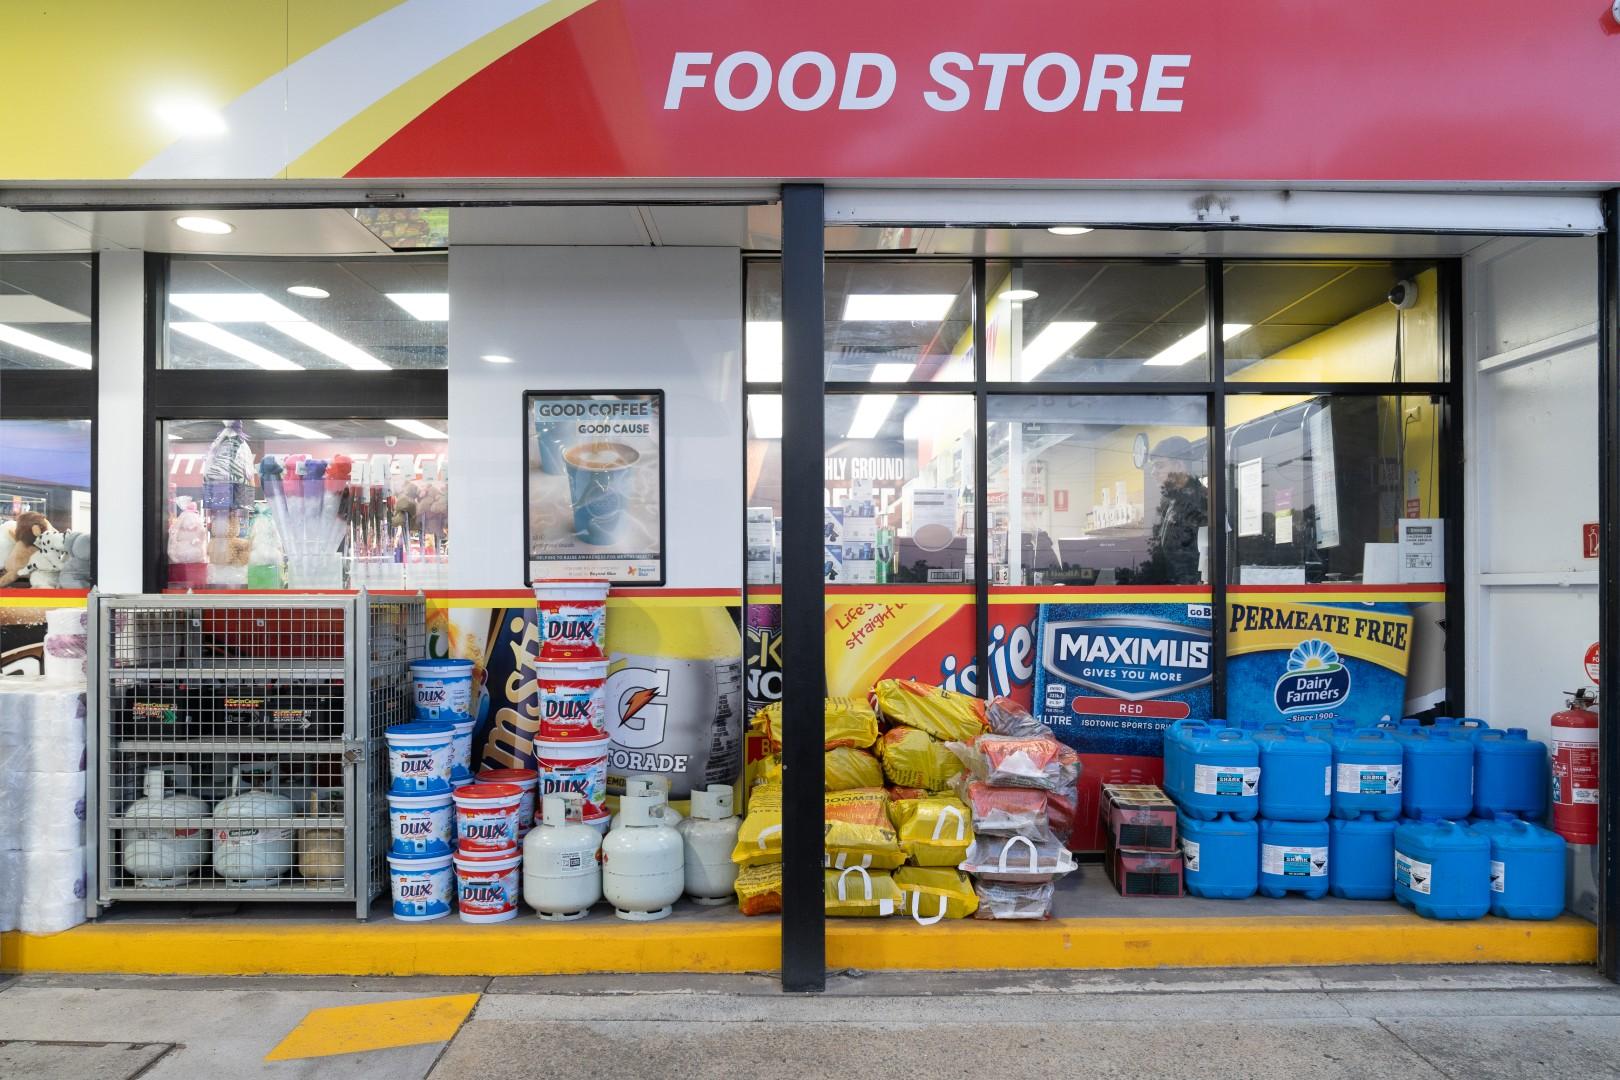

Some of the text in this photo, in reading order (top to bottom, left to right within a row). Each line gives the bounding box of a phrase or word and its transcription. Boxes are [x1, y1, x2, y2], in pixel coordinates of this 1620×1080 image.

[663, 51, 1191, 112] FOOD STORE
[539, 402, 648, 416] GOOD COFFEE
[578, 423, 649, 434] GOOD CAUSE
[851, 457, 904, 480] GROUND
[1190, 607, 1212, 617] GO B
[548, 619, 595, 641] DUX
[845, 605, 896, 650] straight
[1229, 603, 1408, 651] PERMEATE FREE
[1059, 633, 1210, 669] MAXIMUS
[1083, 667, 1182, 682] GIVES YOU MORE
[1296, 676, 1332, 691] Dairy
[418, 689, 446, 703] DUX
[1286, 688, 1340, 703] Farmers
[545, 699, 592, 720] DUX
[1119, 704, 1143, 714] RED
[1315, 712, 1334, 720] 1900
[1044, 716, 1072, 726] LITRE
[1082, 719, 1119, 728] ISOTONIC
[1122, 721, 1153, 729] SPORTS
[401, 758, 433, 774] DUX
[544, 777, 590, 799] DUX
[400, 821, 432, 835] DUX
[466, 823, 508, 839] DUX
[400, 883, 432, 897] DUX
[463, 886, 504, 902] DUX
